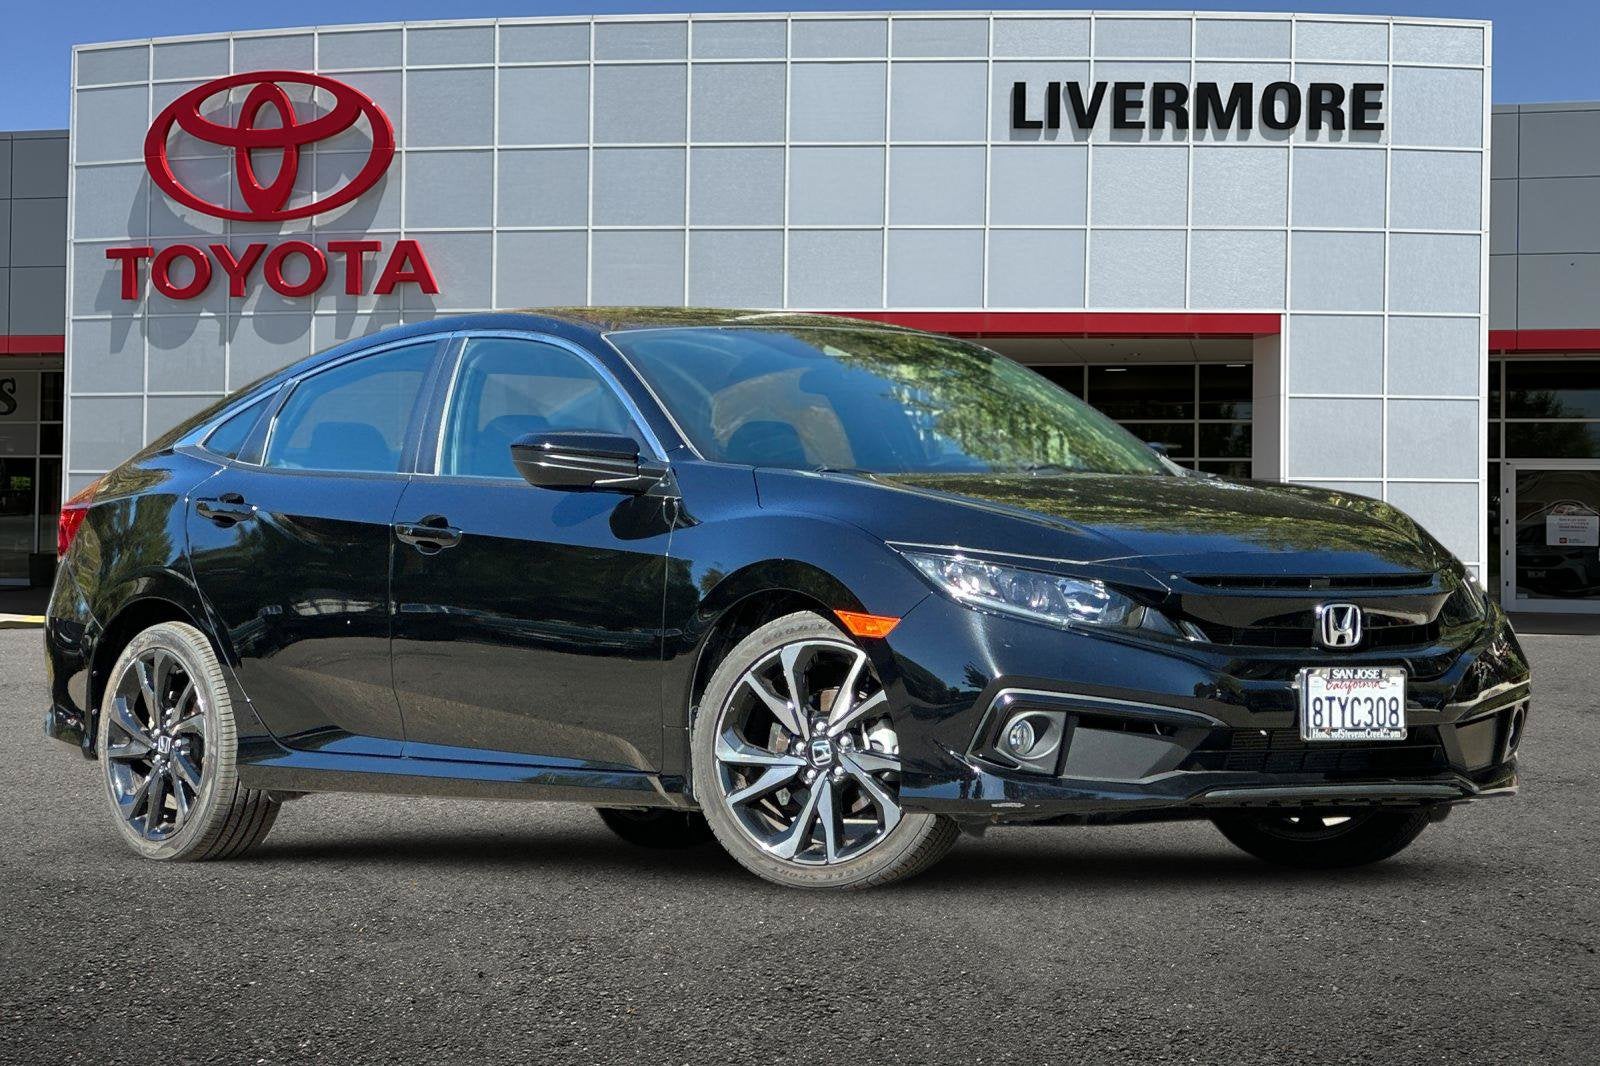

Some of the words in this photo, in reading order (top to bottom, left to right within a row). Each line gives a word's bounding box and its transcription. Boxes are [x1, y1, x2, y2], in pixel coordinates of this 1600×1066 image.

[1013, 81, 1384, 131] LIVERMORE
[105, 239, 440, 300] TOYOTA
[1325, 680, 1383, 694] California
[1332, 669, 1354, 679] SAN
[1354, 669, 1380, 679] JOSE
[1312, 696, 1399, 727] 8TYC308
